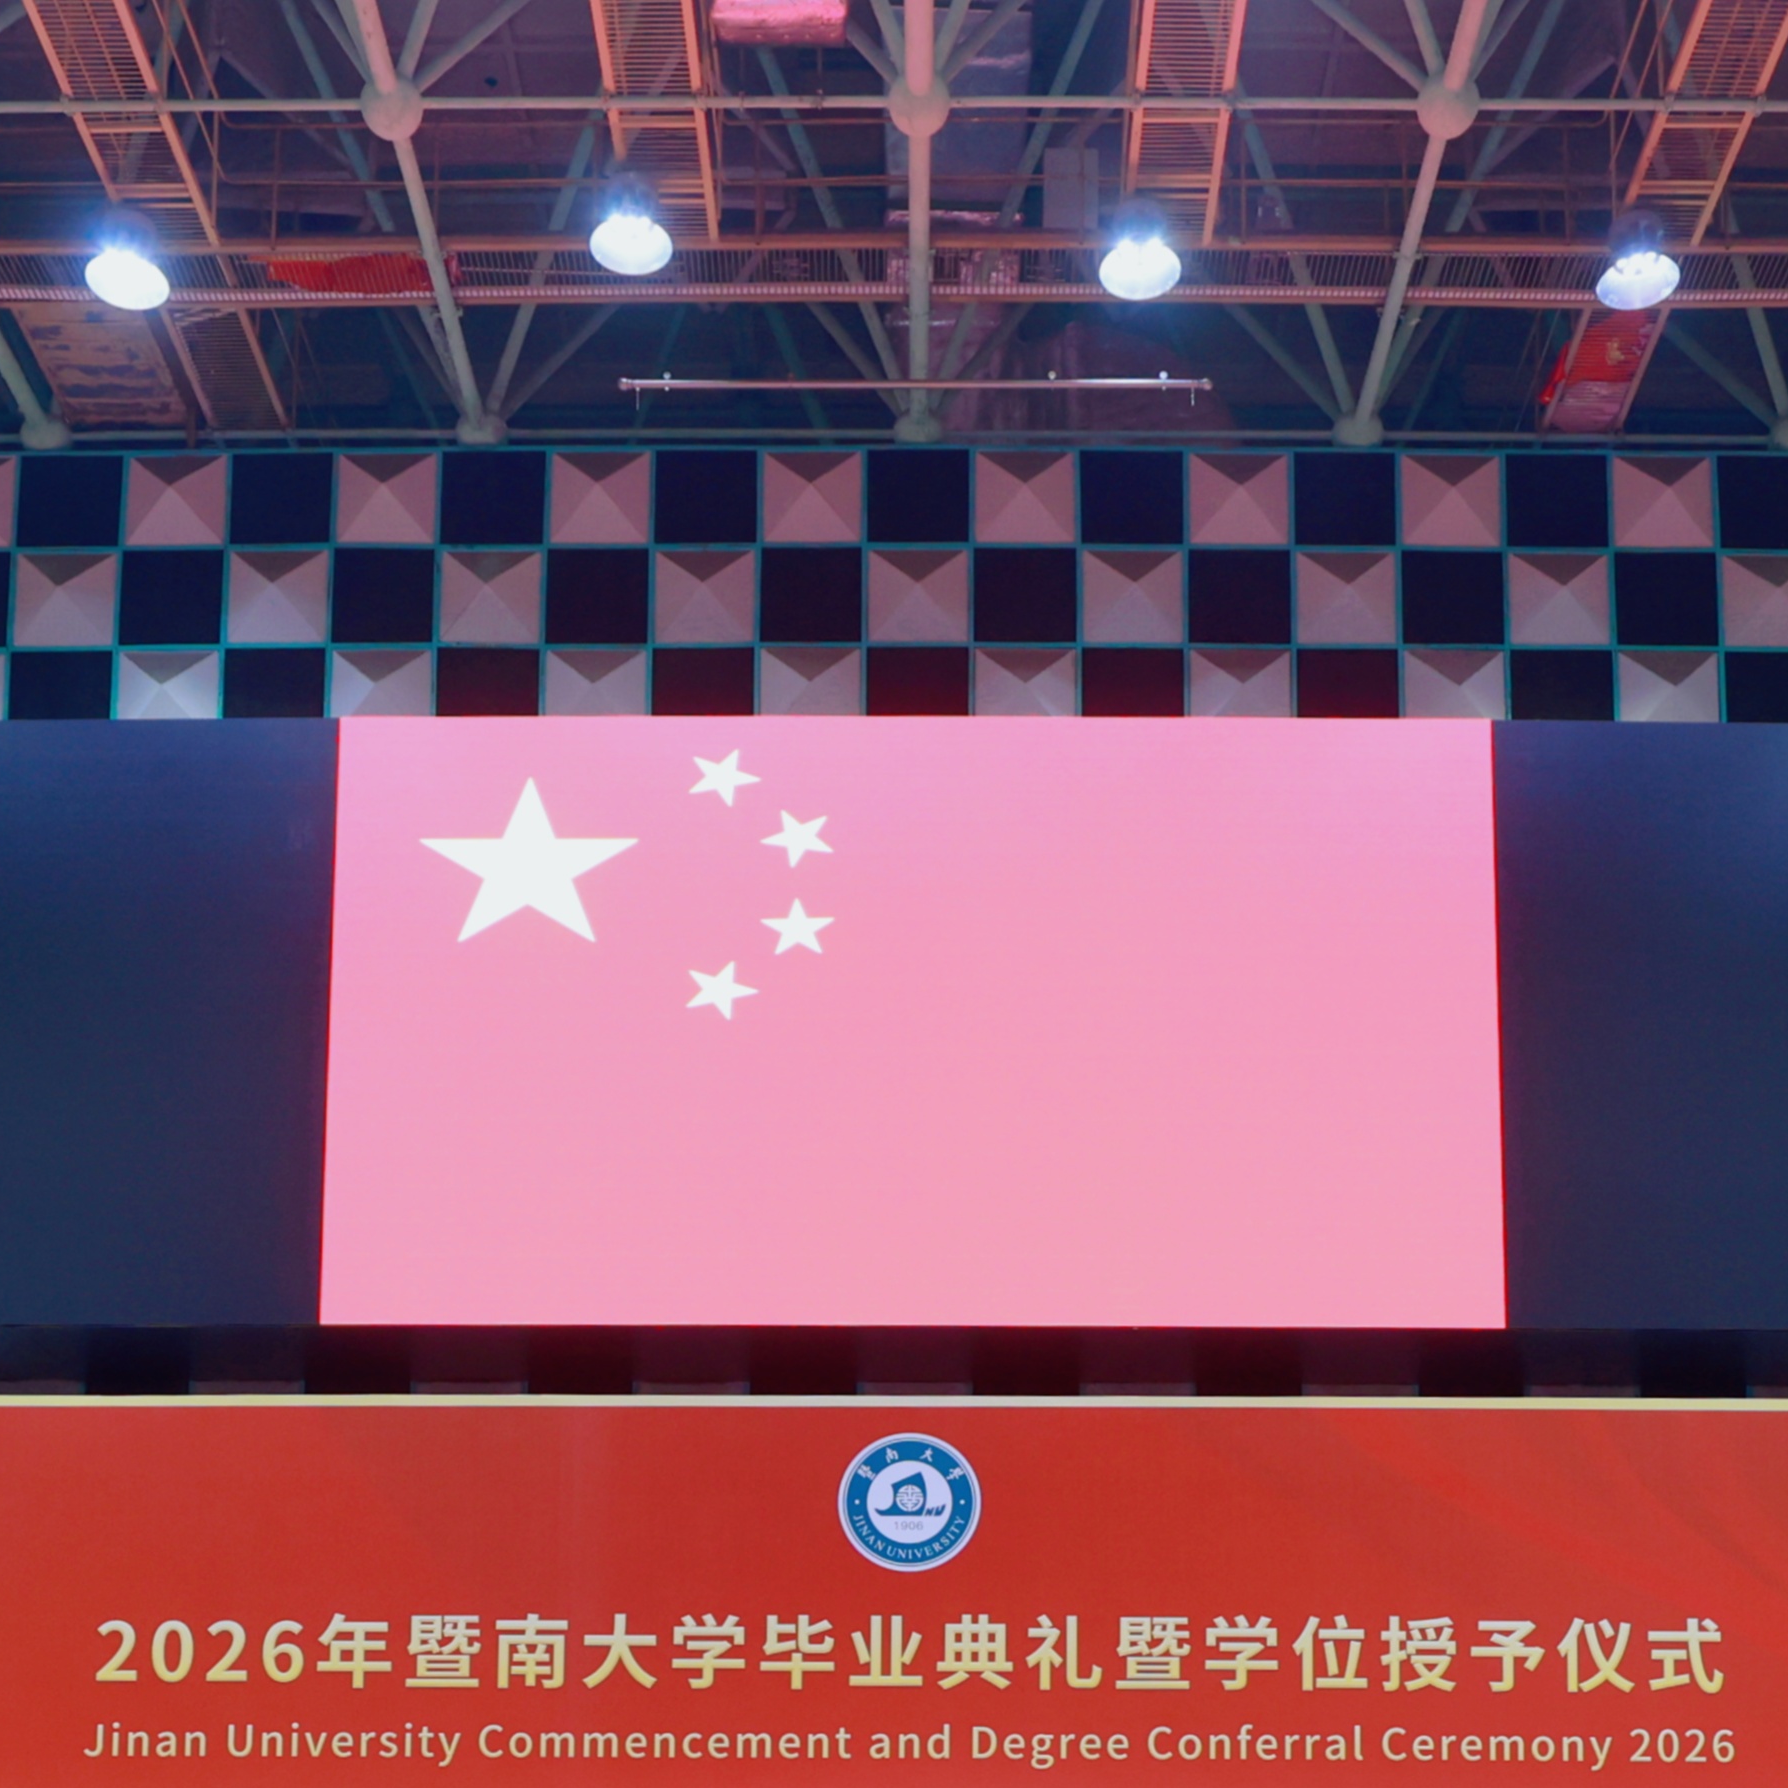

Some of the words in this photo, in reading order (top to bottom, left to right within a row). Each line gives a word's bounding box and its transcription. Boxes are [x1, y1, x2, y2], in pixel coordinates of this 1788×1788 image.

[853, 1514, 888, 1551] JINAN
[886, 1516, 966, 1560] UNIVERSITY
[893, 1520, 924, 1532] 1906
[95, 1612, 1725, 1693] 2026年暨南大学毕业典礼暨学位授予仪式
[83, 1721, 207, 1757] Jinan
[226, 1721, 462, 1767] University
[478, 1723, 852, 1759] Commencement
[869, 1723, 951, 1759] and
[971, 1725, 1130, 1770] Degree
[1146, 1723, 1364, 1761] Conferral
[1381, 1726, 1613, 1771] Ceremony
[1629, 1728, 1735, 1763] 2026
